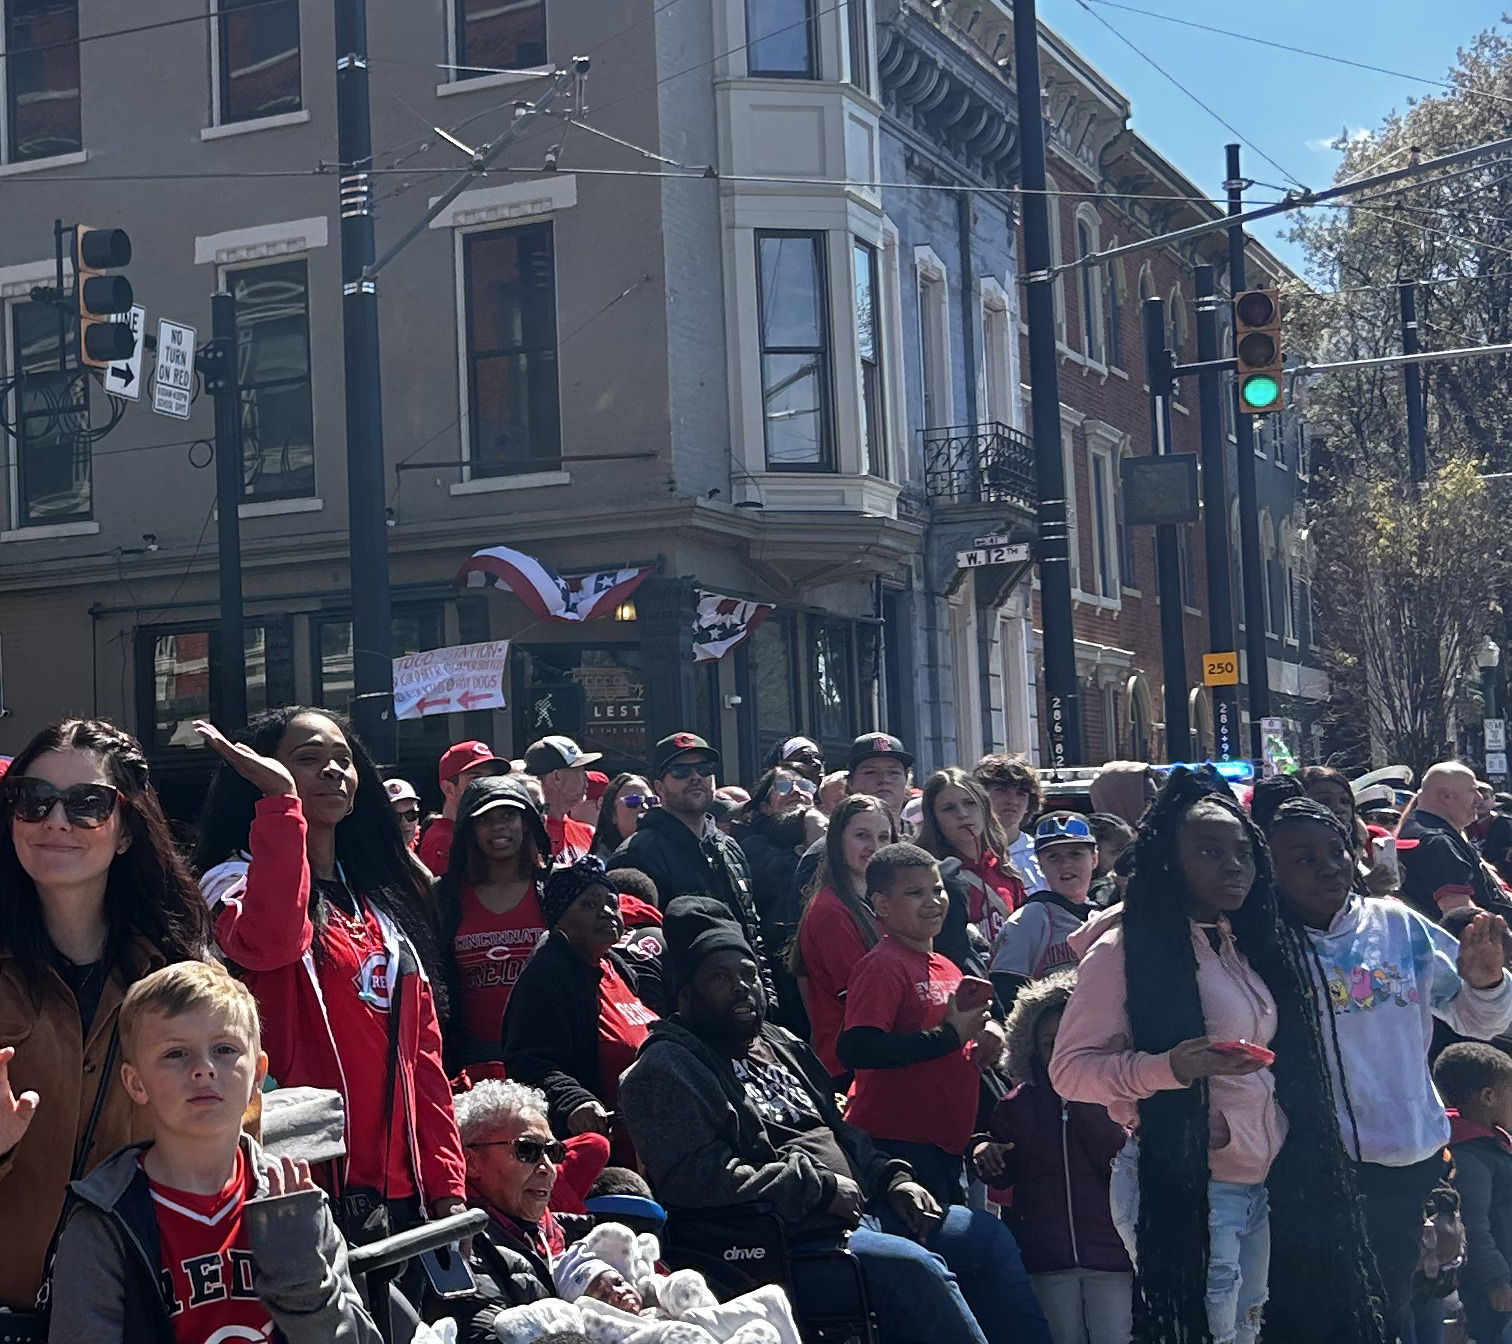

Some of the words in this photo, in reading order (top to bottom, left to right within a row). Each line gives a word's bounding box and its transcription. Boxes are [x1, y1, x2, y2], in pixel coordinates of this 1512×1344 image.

[171, 328, 184, 346] NO
[165, 346, 187, 367] TURN
[159, 363, 171, 381] ON
[173, 368, 189, 387] RED
[1208, 663, 1234, 675] 250
[454, 927, 546, 952] CINCINNAT
[371, 975, 387, 989] RE
[723, 1245, 766, 1261] drive
